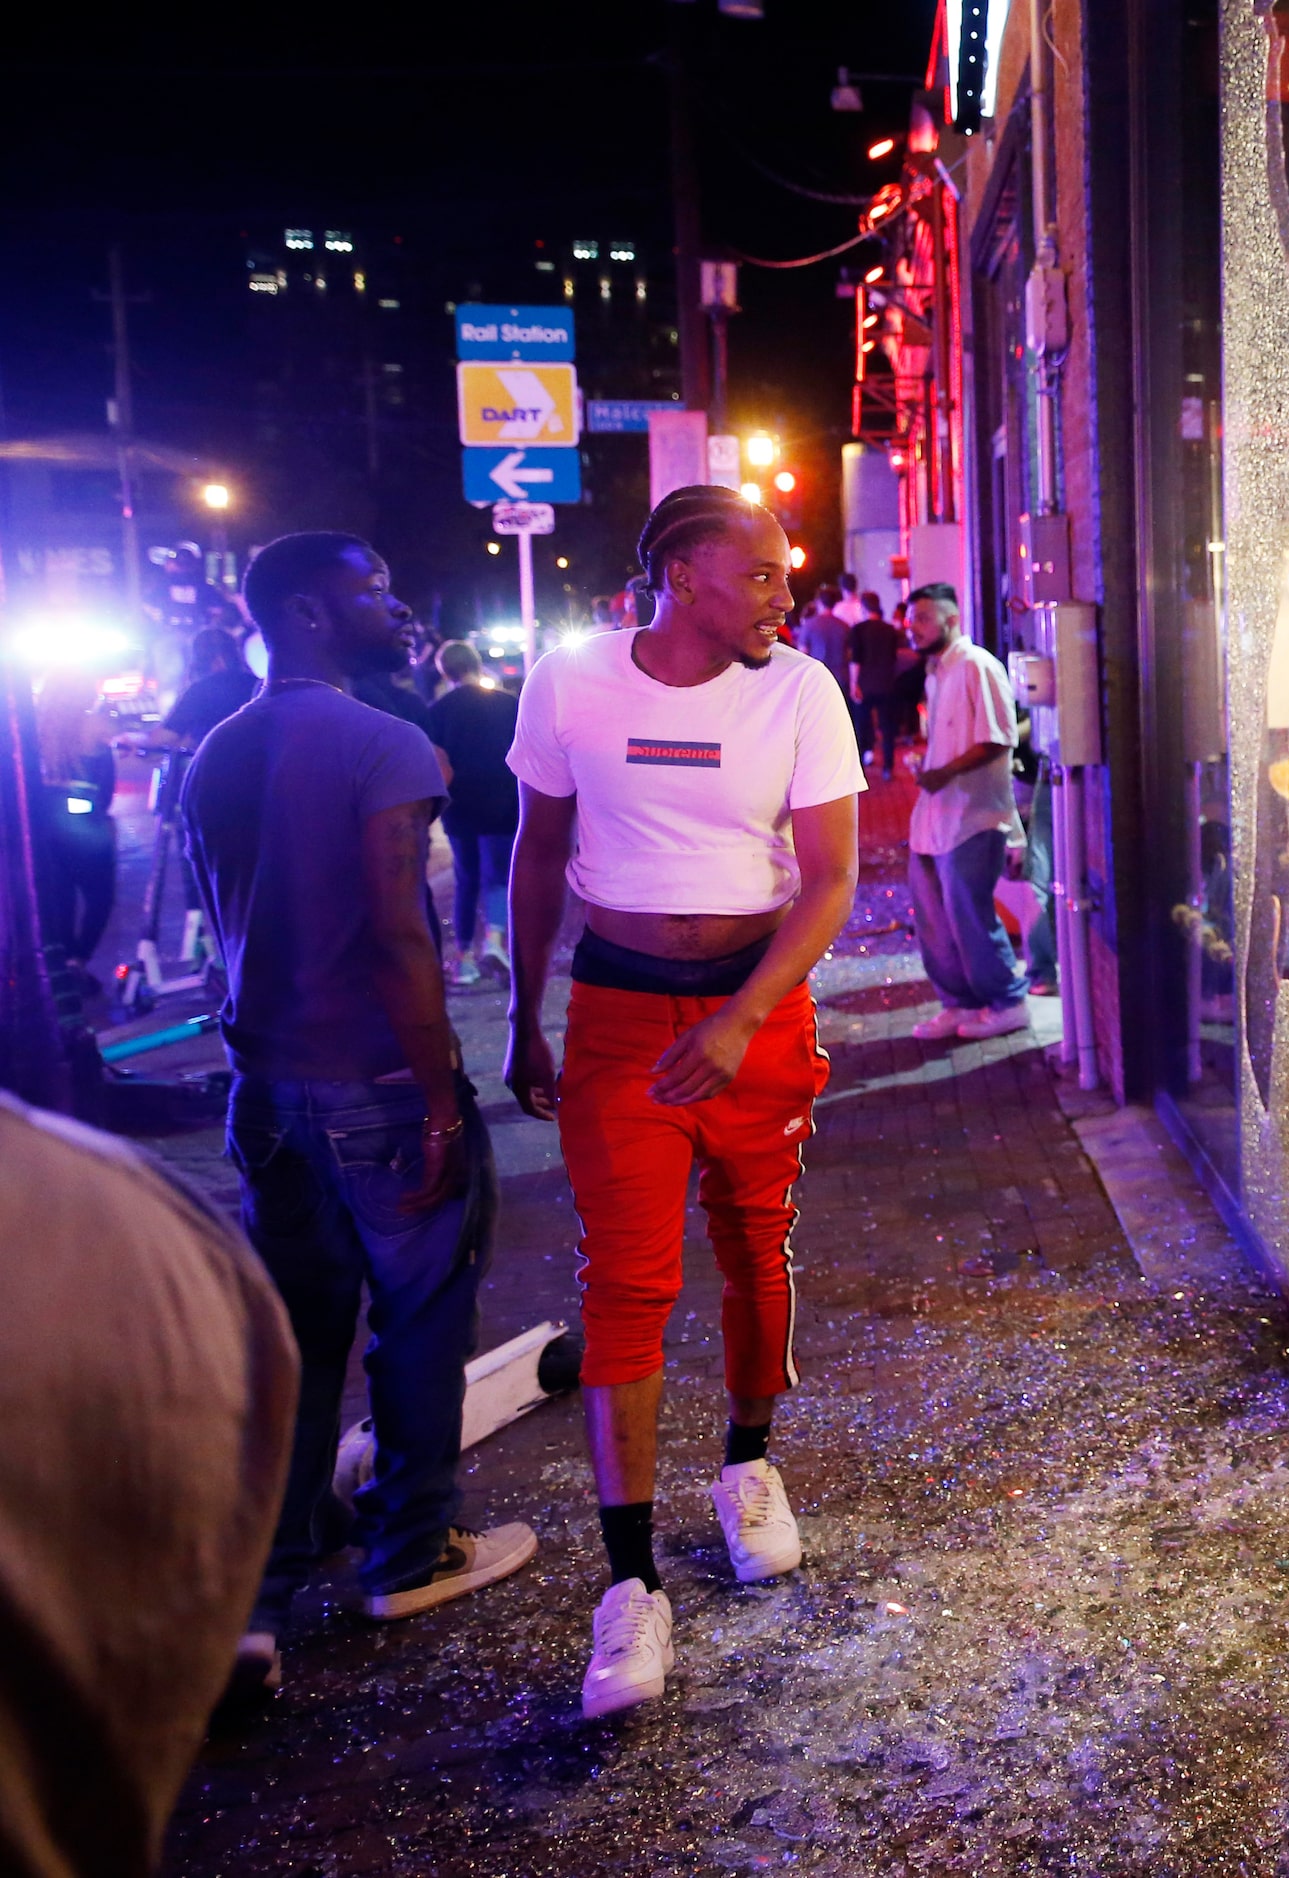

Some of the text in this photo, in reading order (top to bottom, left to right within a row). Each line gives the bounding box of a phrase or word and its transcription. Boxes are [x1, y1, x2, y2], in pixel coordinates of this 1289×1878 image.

[461, 323, 568, 344] Rail Station
[481, 407, 542, 422] DART
